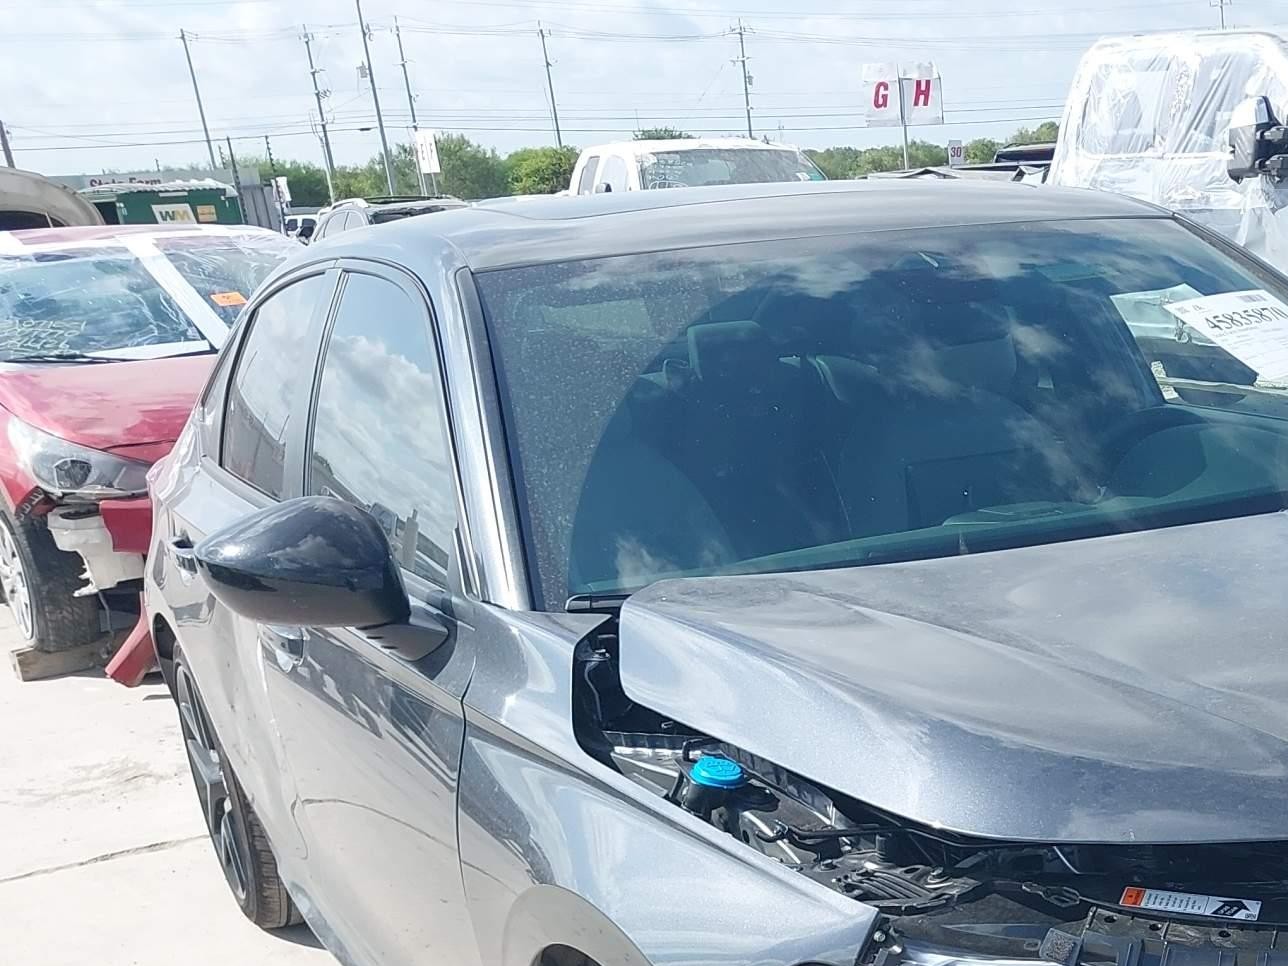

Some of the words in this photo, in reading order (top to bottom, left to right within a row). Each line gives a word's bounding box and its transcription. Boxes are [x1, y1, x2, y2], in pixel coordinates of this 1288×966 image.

[874, 81, 889, 109] G
[913, 79, 931, 106] H
[950, 146, 962, 158] 30
[159, 209, 191, 221] WM
